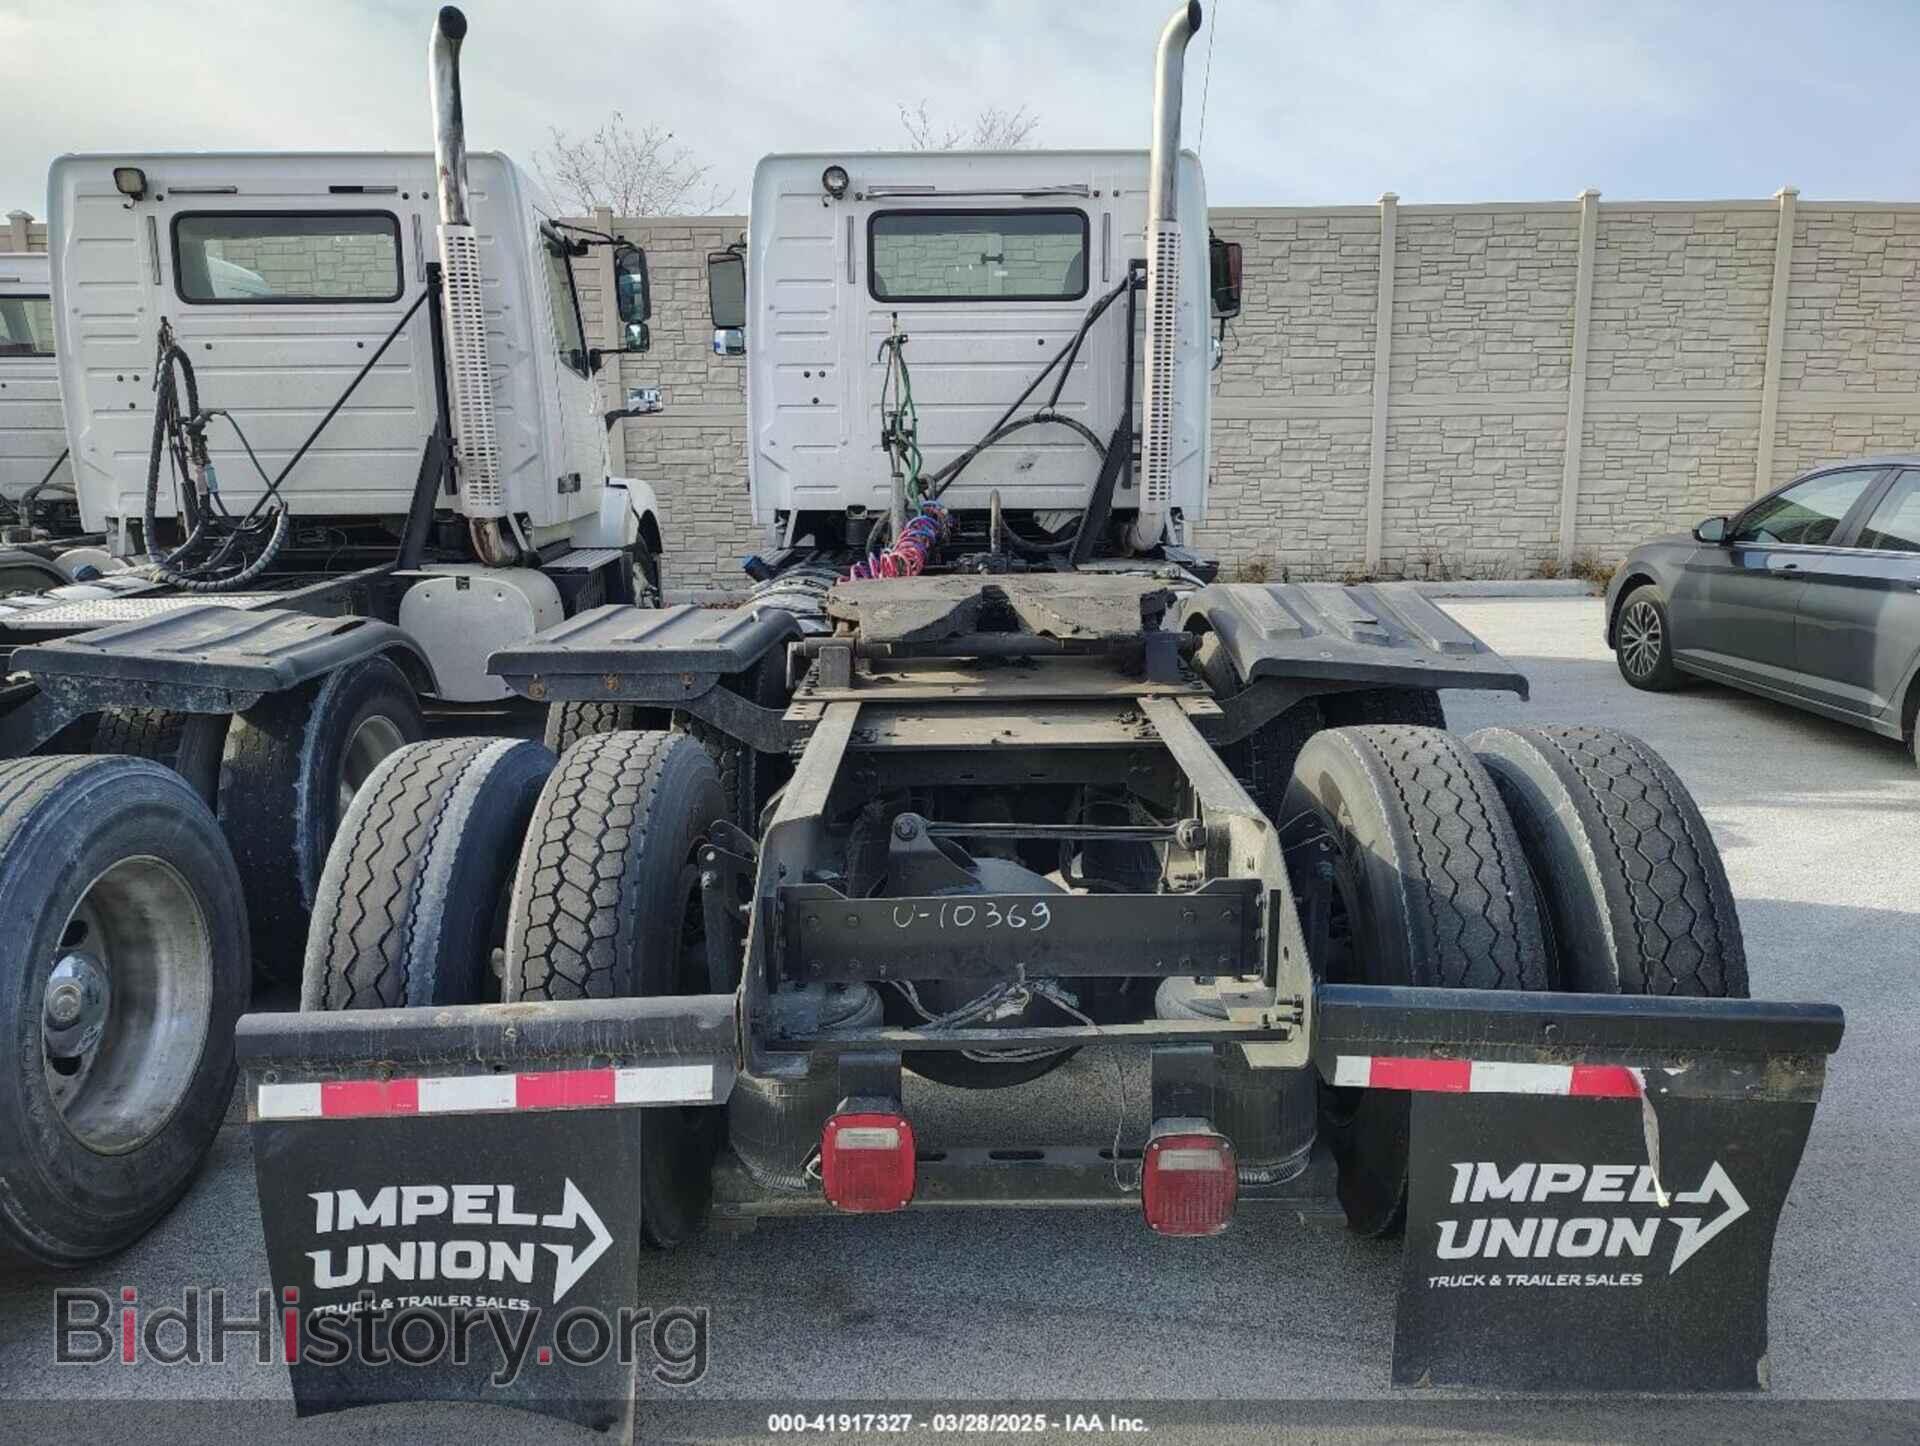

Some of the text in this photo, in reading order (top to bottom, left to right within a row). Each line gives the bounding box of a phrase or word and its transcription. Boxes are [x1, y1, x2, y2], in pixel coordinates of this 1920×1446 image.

[1451, 1162, 1671, 1203] IMPEL
[307, 1184, 537, 1234] IMPEL
[1436, 1217, 1661, 1259] UNION
[305, 1240, 535, 1289] UNION
[1428, 1273, 1643, 1288] TRUCK & TRAILER SALES
[381, 1298, 394, 1309] &
[397, 1295, 473, 1309] TRAILER
[475, 1296, 530, 1311] SALES
